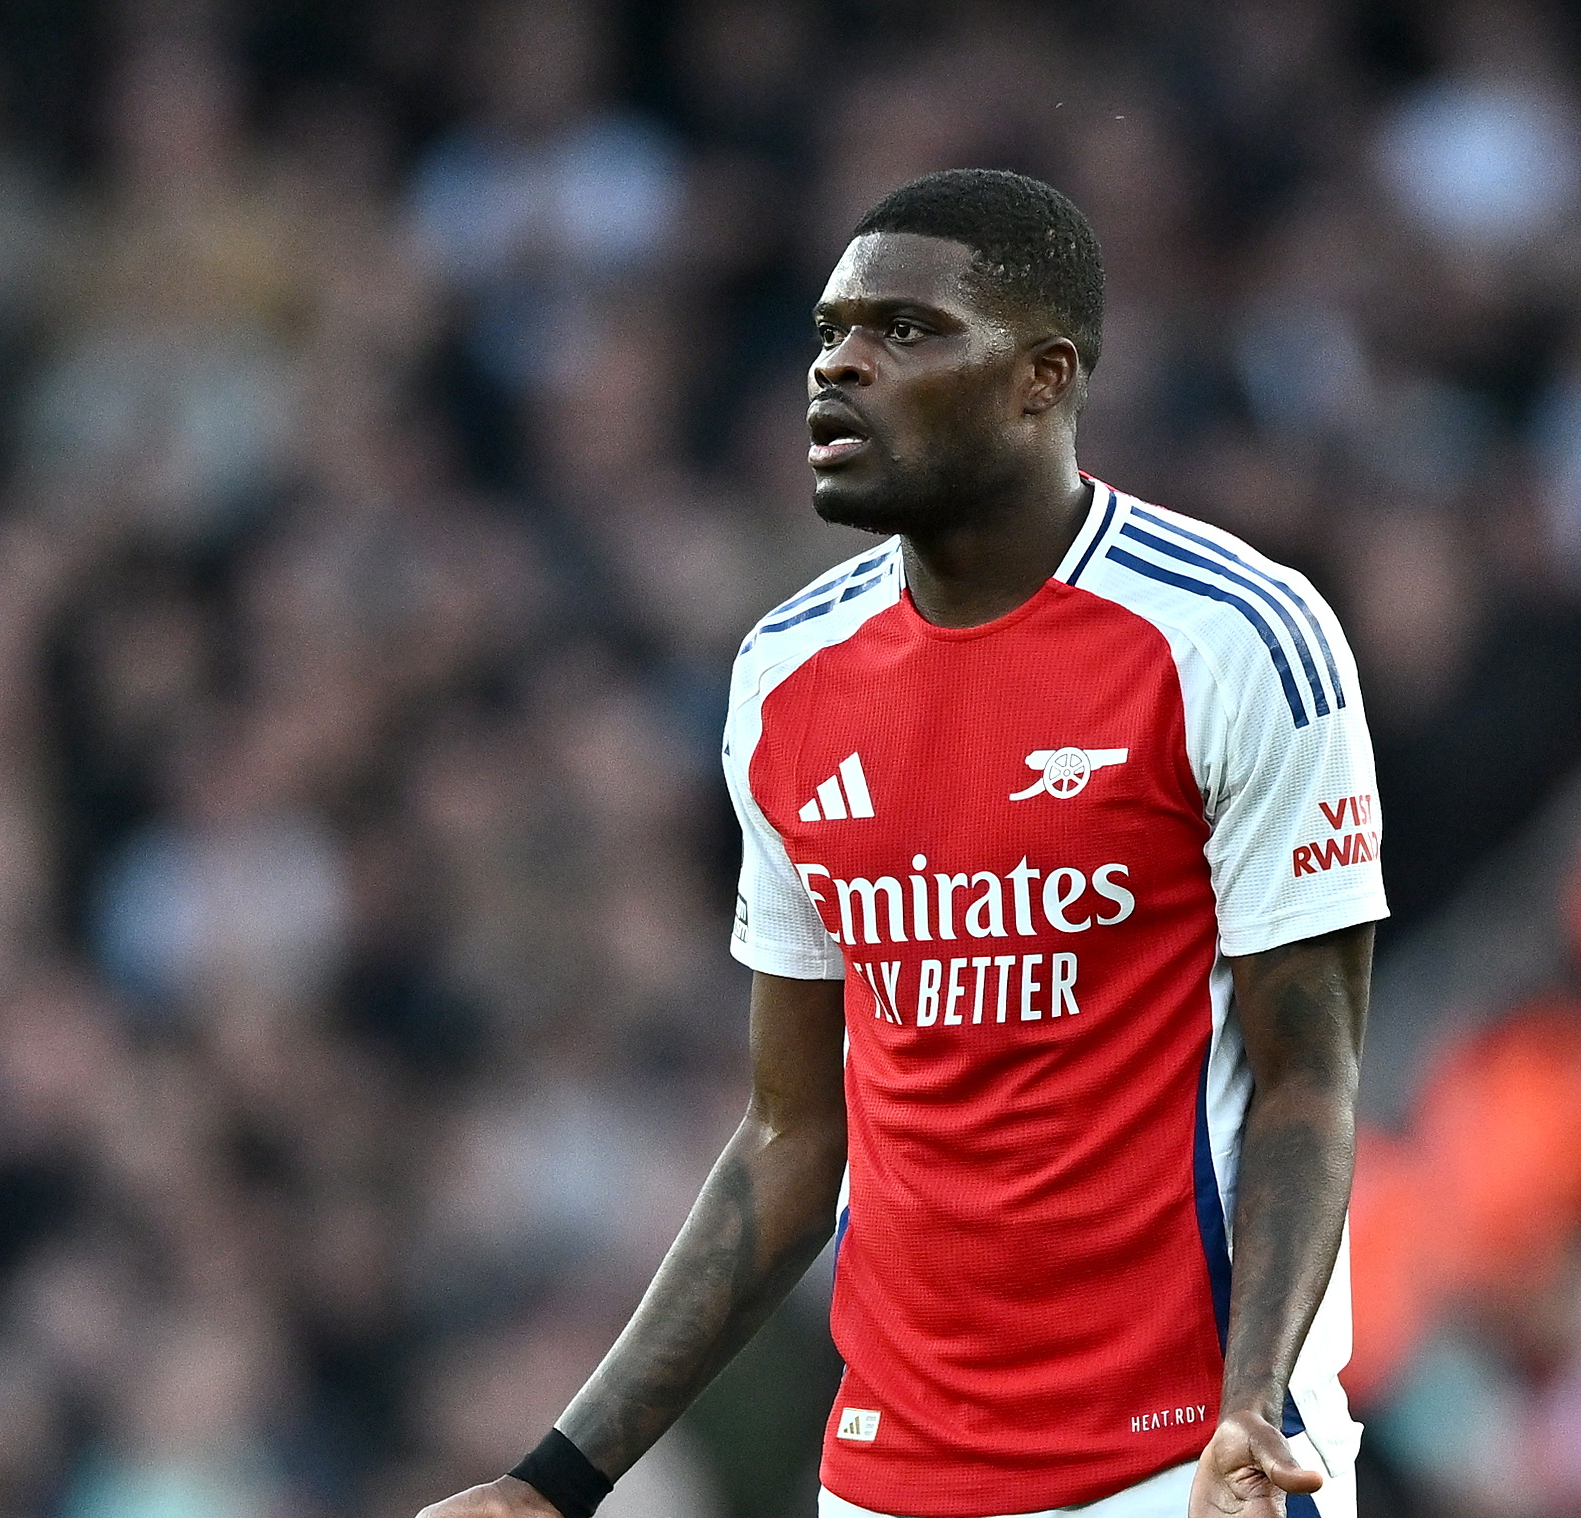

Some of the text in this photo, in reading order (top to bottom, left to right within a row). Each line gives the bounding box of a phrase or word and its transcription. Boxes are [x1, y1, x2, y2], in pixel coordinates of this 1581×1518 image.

[794, 853, 1136, 945] Emirates
[916, 952, 1080, 1027] BETTER
[1131, 1404, 1206, 1433] HEAT.RDY
